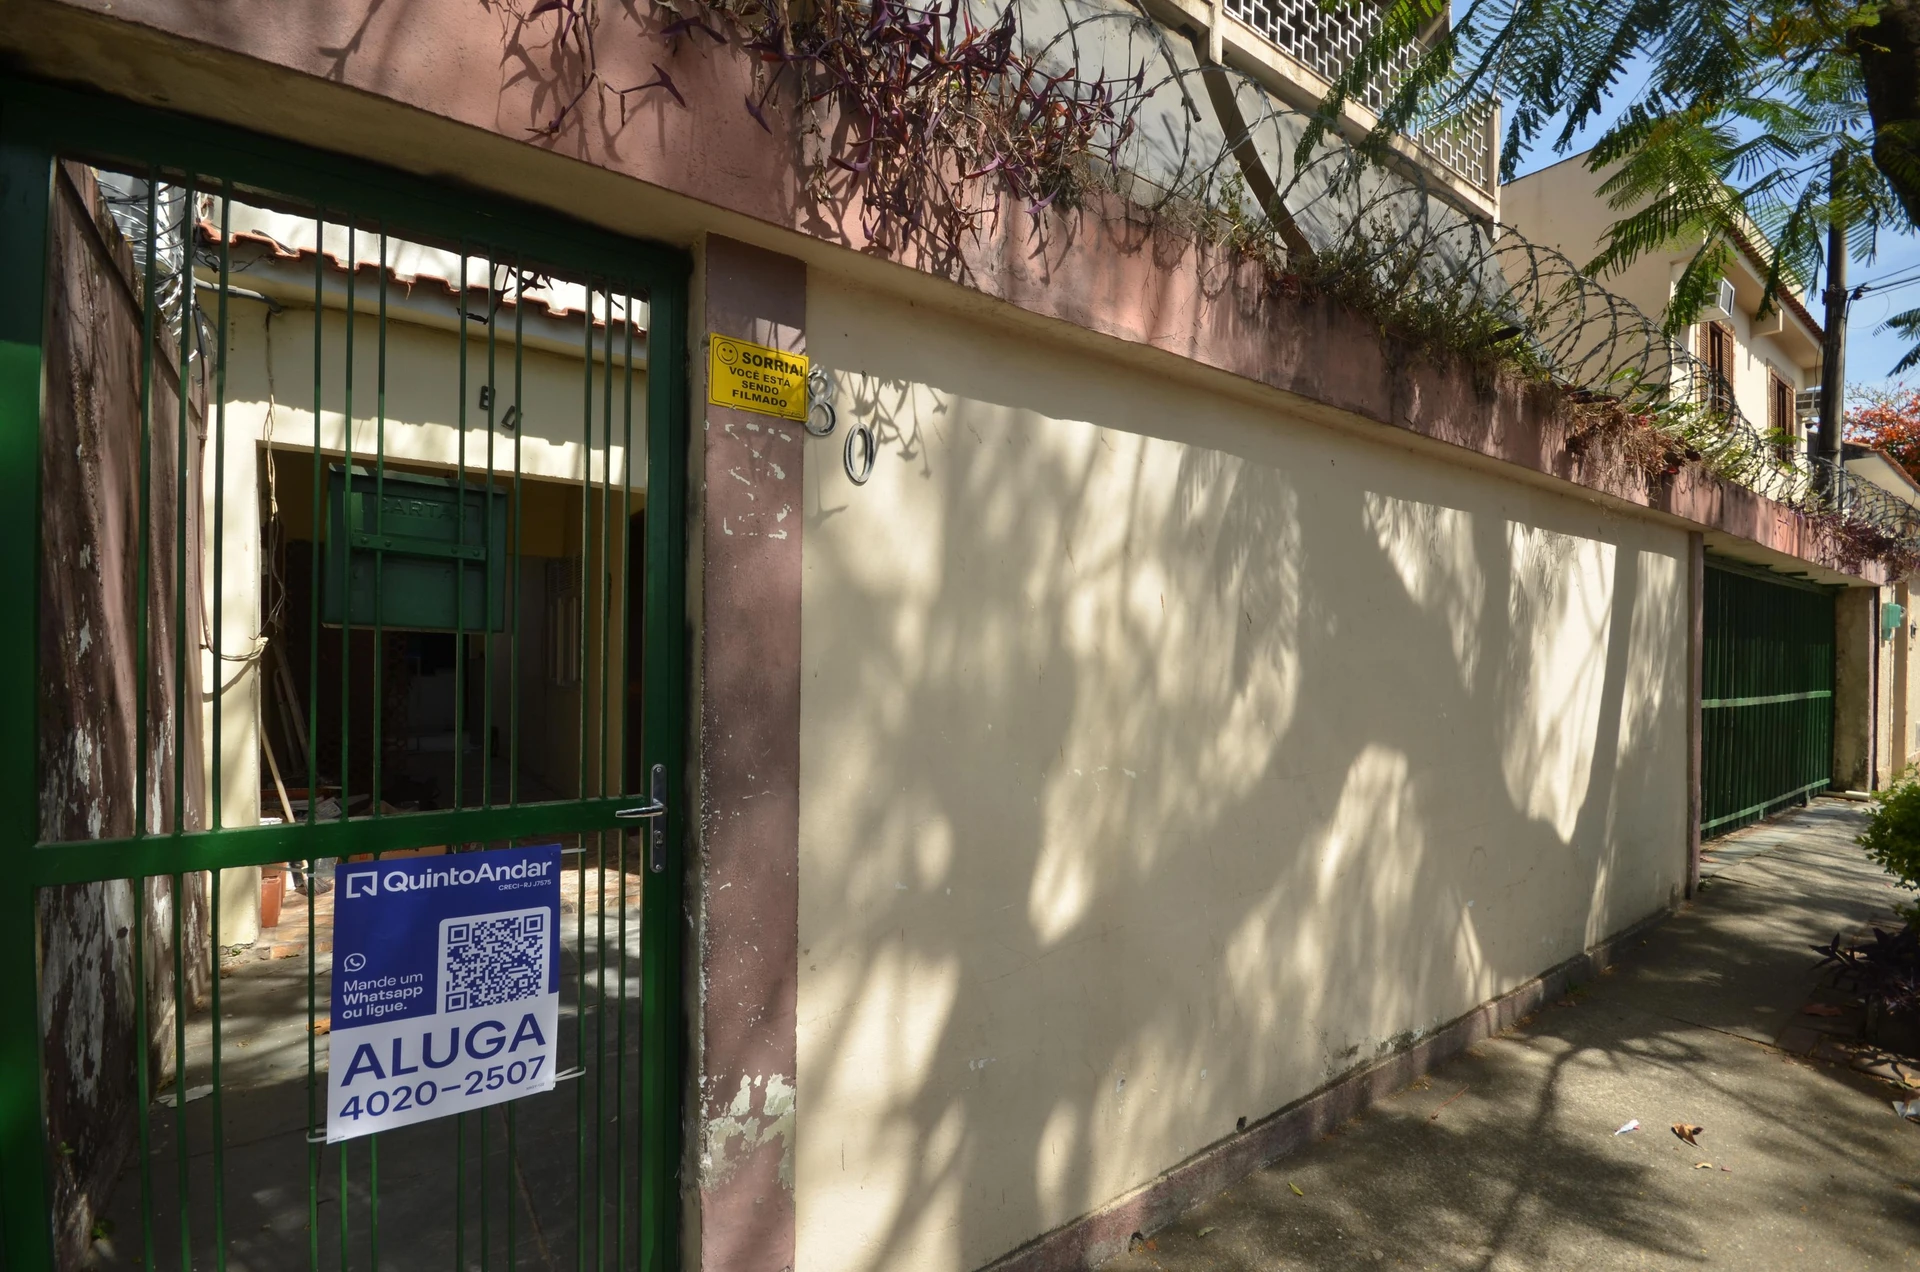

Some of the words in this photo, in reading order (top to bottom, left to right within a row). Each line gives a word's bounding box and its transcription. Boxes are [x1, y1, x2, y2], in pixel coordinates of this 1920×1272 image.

[742, 351, 803, 377] SORRIA!
[729, 366, 760, 381] VOCÊ
[763, 373, 791, 388] ESTÁ
[741, 380, 779, 396] SENDO
[732, 389, 788, 408] FILMADO
[805, 368, 876, 485] 80
[383, 859, 552, 893] QuintoAndar
[498, 881, 532, 891] CRECI-RJ
[533, 879, 552, 887] J7575
[343, 975, 397, 993] Mande
[399, 972, 424, 986] um
[342, 984, 424, 1006] Whatsapp
[342, 1005, 363, 1020] ou
[366, 1001, 408, 1018] ligue.
[340, 1012, 547, 1088] ALUGA
[339, 1055, 547, 1121] 4020-2507
